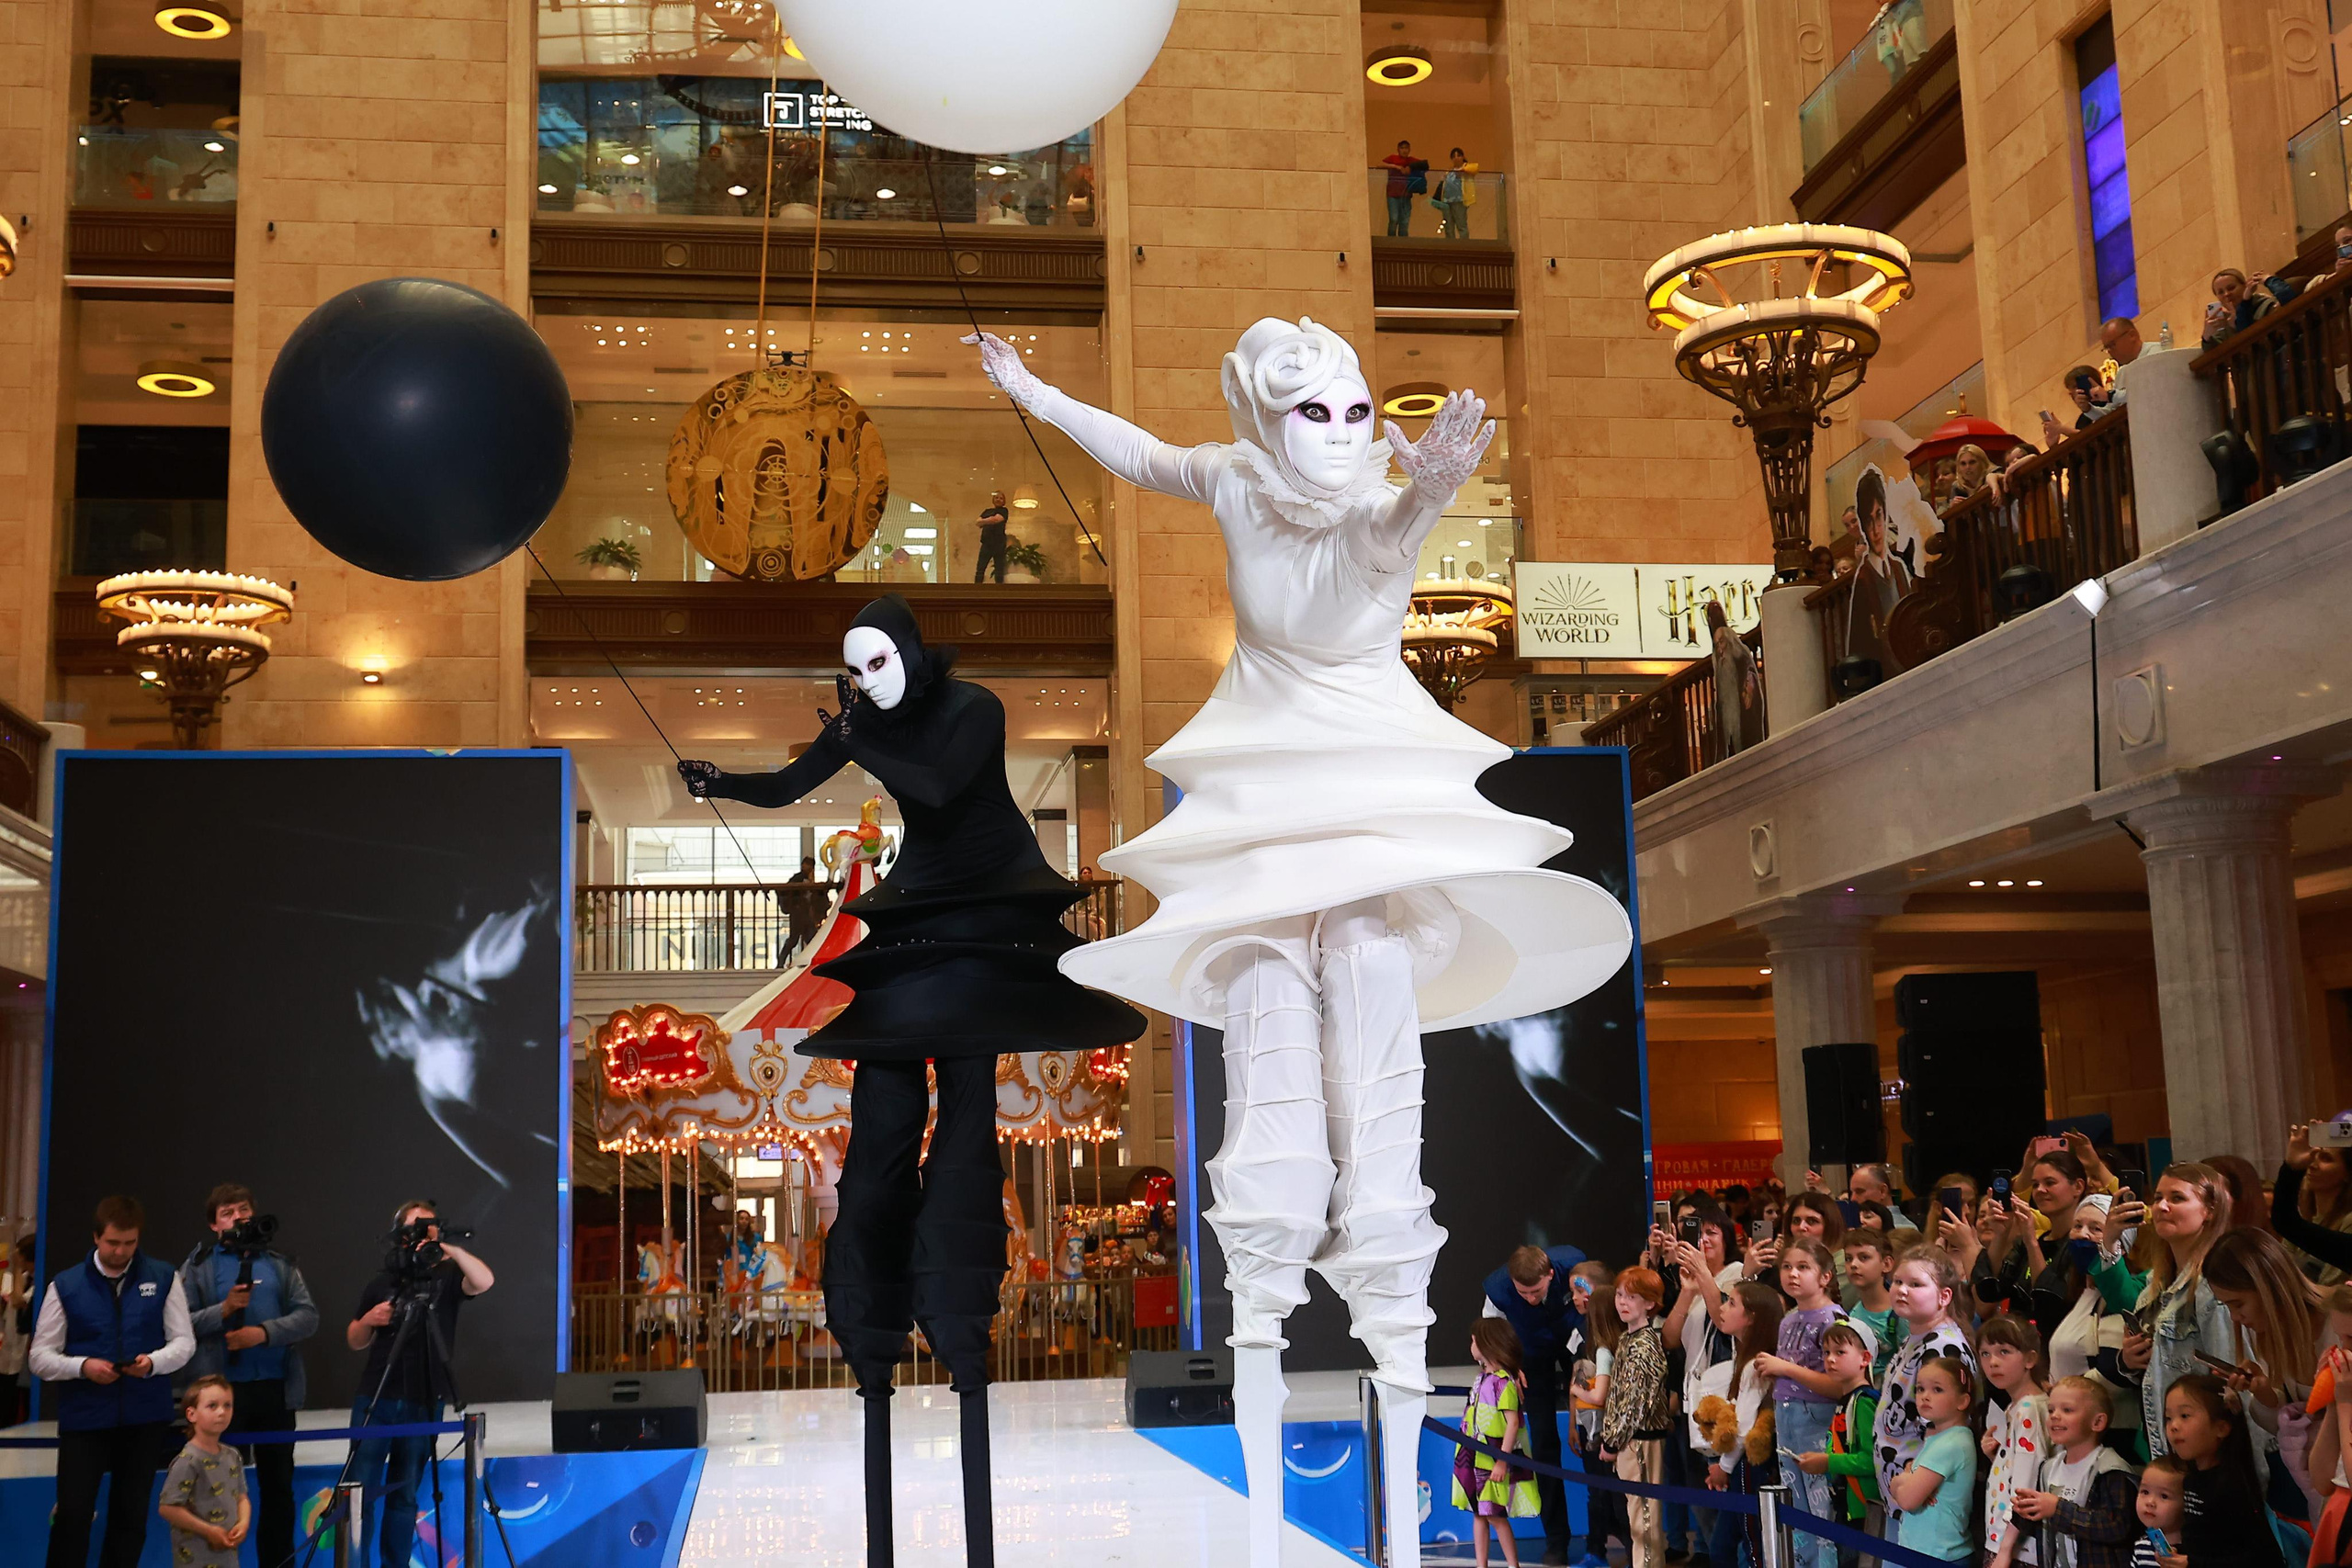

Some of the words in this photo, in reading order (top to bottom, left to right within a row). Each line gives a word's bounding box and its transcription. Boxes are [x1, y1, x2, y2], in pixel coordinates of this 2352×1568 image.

[809, 94, 839, 106] TOP
[846, 119, 872, 131] ING
[1521, 612, 1619, 627] WIZARDING
[1534, 627, 1610, 643] WORLD
[1654, 1159, 1710, 1175] ГРОВАЯ
